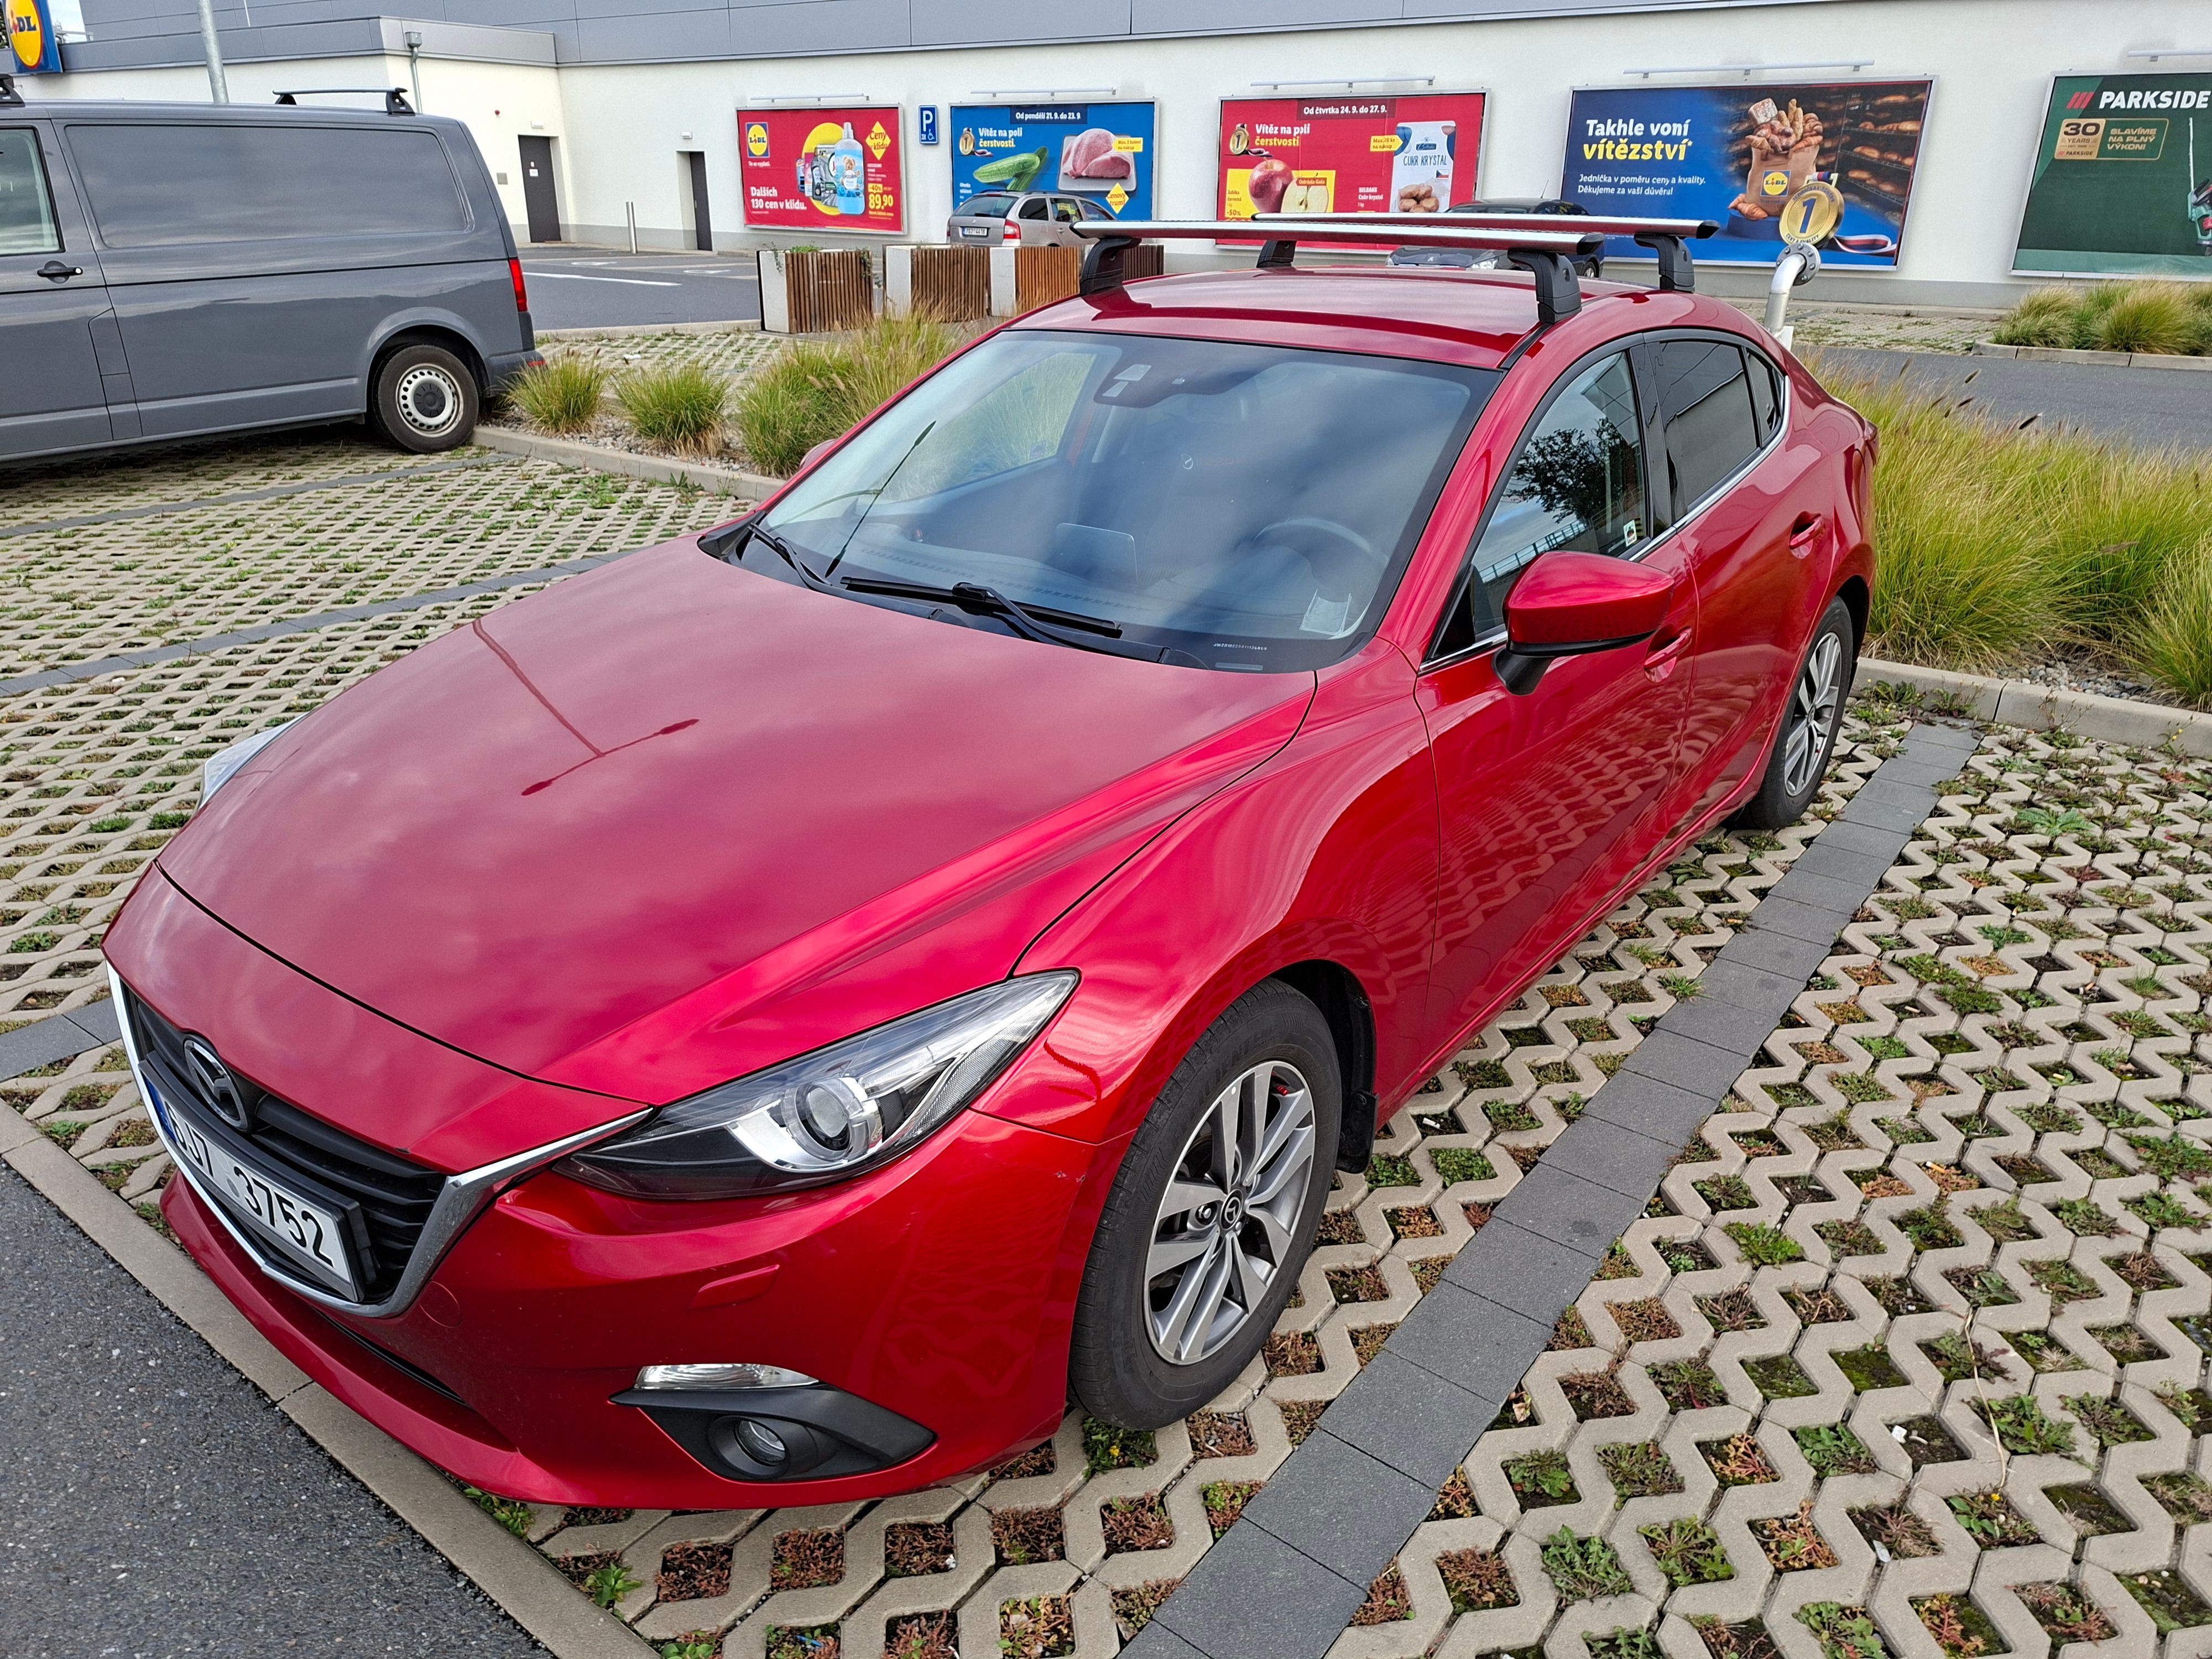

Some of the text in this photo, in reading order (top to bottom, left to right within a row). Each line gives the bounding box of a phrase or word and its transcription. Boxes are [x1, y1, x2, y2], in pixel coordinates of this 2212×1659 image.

[2099, 91, 2211, 109] PARKSIDE
[1315, 106, 1339, 114] čtvrtka
[1340, 106, 1350, 114] 24.
[1359, 105, 1369, 113] do
[1370, 105, 1379, 113] 27.
[1380, 105, 1387, 113] 9.
[923, 110, 933, 132] P
[1025, 112, 1046, 121] pondělí
[978, 127, 997, 137] Vítěz
[1008, 127, 1022, 139] poli
[1255, 123, 1279, 134] Vítěz
[1280, 126, 1292, 134] na
[1586, 119, 1691, 136] Takhle voní
[2063, 122, 2100, 136] 30
[2110, 127, 2157, 135] SLAVÍME
[979, 138, 1016, 148] čerstvosti.
[1403, 154, 1447, 166] CUKR KRYSTAL
[1579, 174, 1611, 182] Jednička
[1620, 175, 1650, 185] poměru
[1652, 177, 1670, 186] ceny
[1678, 175, 1706, 185] kvality.
[750, 186, 778, 196] Dalších
[1578, 185, 1615, 195] Děkujeme
[1627, 186, 1642, 195] vaši
[751, 198, 764, 208] 130
[785, 199, 807, 210] klidu.
[1799, 197, 1817, 233] 1
[165, 1100, 334, 1268] 6J7 3752
